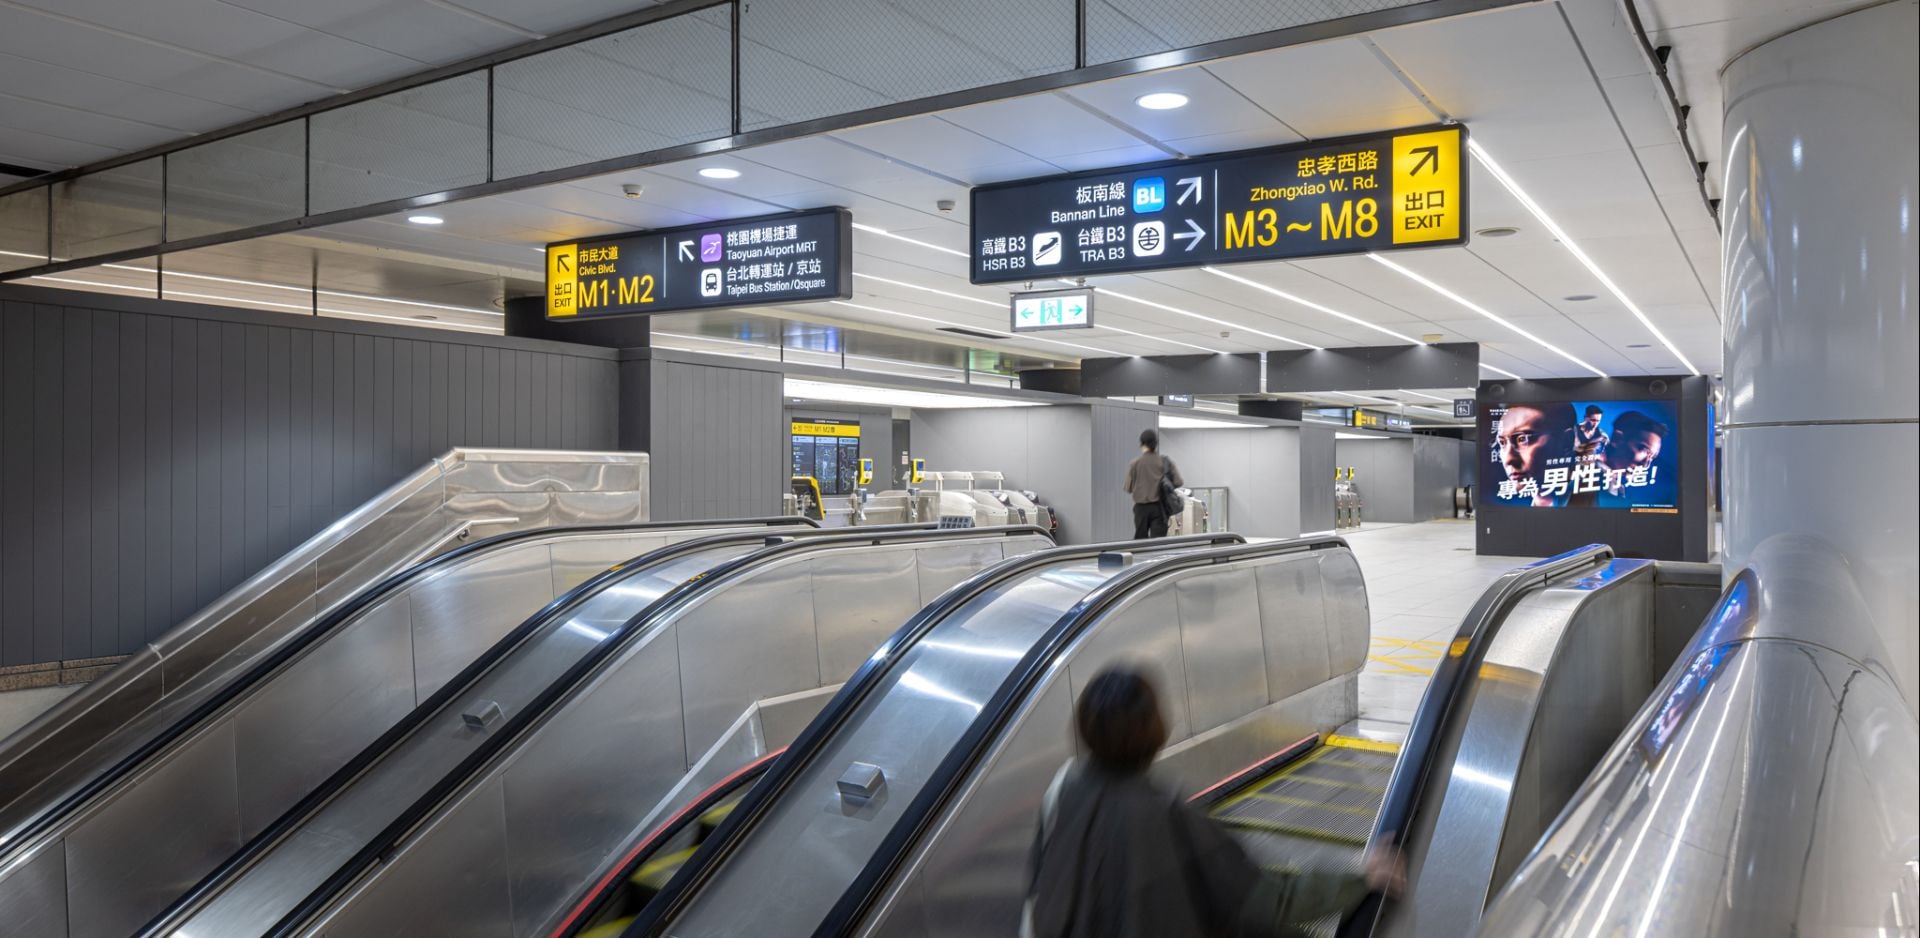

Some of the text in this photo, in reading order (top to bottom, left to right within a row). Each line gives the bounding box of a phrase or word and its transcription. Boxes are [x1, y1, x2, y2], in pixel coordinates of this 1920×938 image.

[1297, 150, 1378, 178] 忠孝西路
[1076, 182, 1126, 205] 板南線
[1136, 187, 1162, 206] BL
[1250, 175, 1379, 202] Zhongxiao W. Rd.
[1404, 190, 1445, 212] 出口
[1051, 204, 1125, 223] Bannan Line
[1404, 213, 1445, 230] EXIT
[1225, 207, 1279, 250] M3
[1320, 197, 1379, 242] M8
[726, 224, 798, 247] 桃園機場捷運
[1077, 226, 1126, 247] 台鐵 B3
[579, 246, 619, 263] 市民大道
[726, 241, 818, 262] Taoyuan Airport MRT
[981, 236, 1026, 256] 高鐵 B3
[1080, 248, 1125, 262] TRA B3
[579, 263, 617, 276] Civic Blvd.
[796, 258, 822, 275] 京站
[983, 257, 1026, 271] HSR B3
[554, 282, 572, 296] 出口
[726, 284, 748, 297] Taipei
[749, 283, 763, 294] Bus
[554, 297, 572, 308] EXIT
